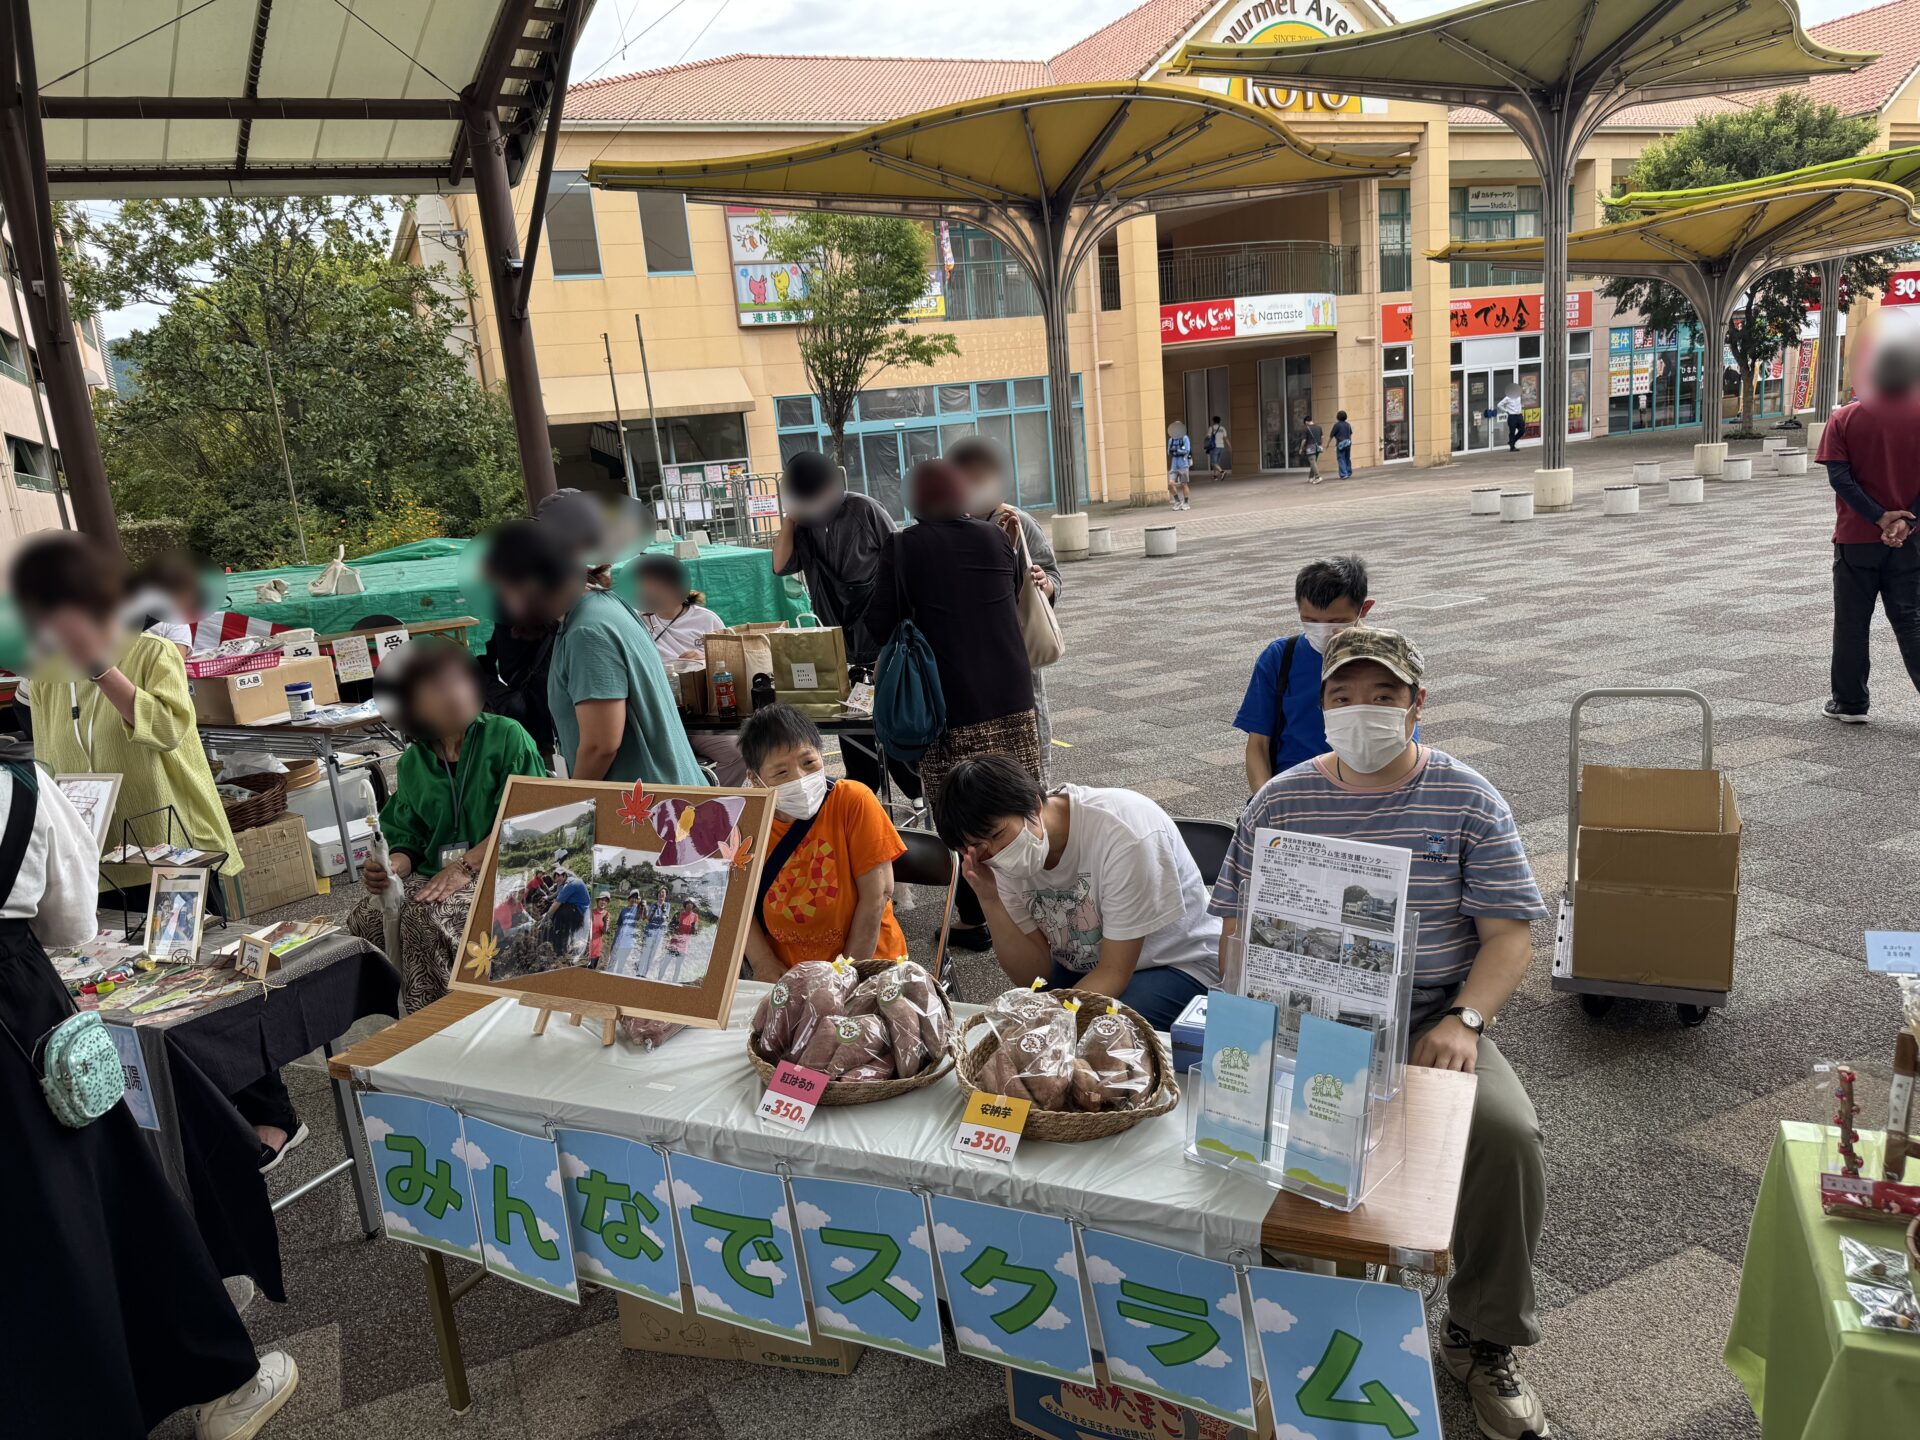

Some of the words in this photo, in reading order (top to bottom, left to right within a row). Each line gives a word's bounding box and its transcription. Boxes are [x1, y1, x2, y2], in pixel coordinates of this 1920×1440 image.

[1222, 0, 1297, 43] ourmet
[1305, 0, 1356, 36] Ave
[1273, 34, 1296, 43] SINCE
[1258, 309, 1303, 321] Namaste
[1611, 332, 1629, 348] 整体
[1281, 843, 1389, 865] みんなでスクラム生活支援センター
[780, 1072, 815, 1092] 紅はるか
[981, 1103, 1013, 1119] 安納芋
